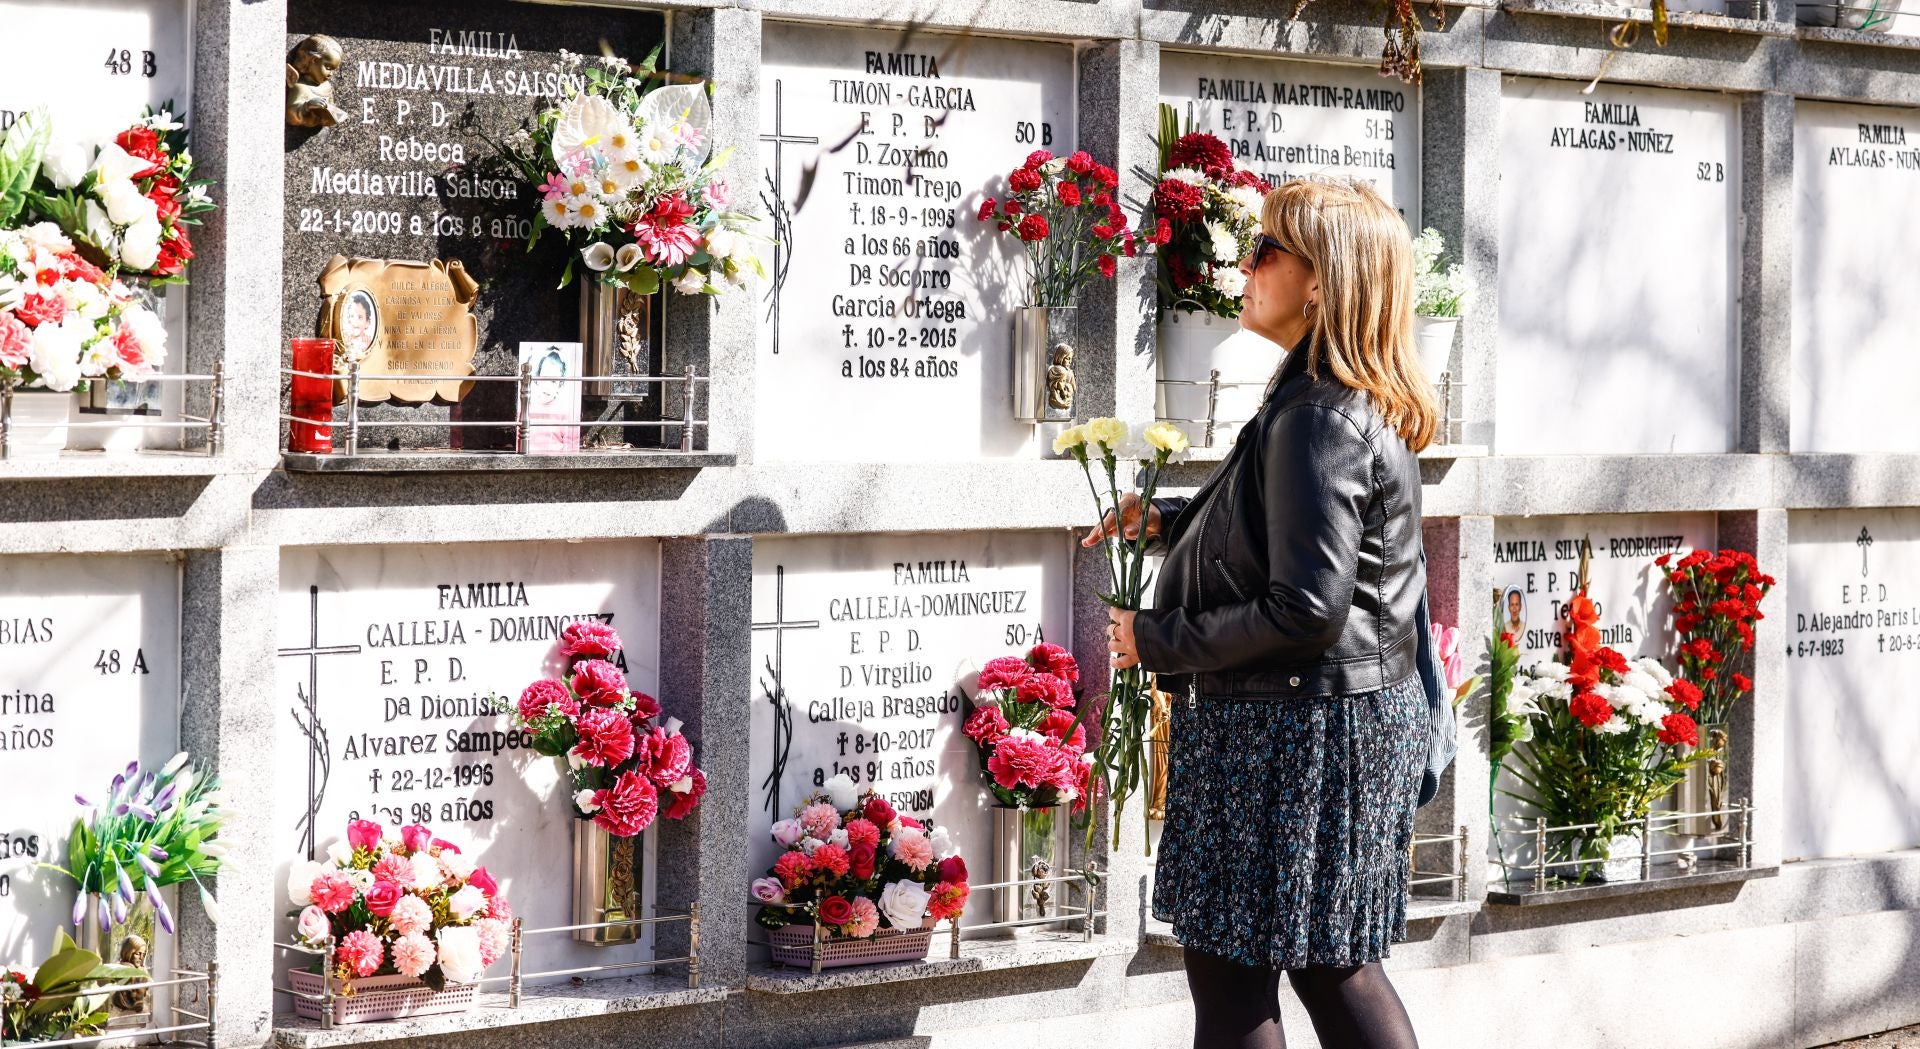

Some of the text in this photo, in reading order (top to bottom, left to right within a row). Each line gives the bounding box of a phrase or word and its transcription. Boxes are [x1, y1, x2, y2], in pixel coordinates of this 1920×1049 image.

[429, 28, 522, 59] FAMILIA
[104, 48, 157, 78] 48 B
[865, 51, 940, 79] FAMILIA
[830, 79, 891, 106] TIMON
[908, 86, 976, 111] GARCIA
[1198, 77, 1405, 113] FAMILIA MARTIN-RAMIRO
[362, 98, 450, 127] E. P. D.
[860, 111, 939, 138] E. P. D.
[1223, 108, 1235, 131] E.
[1247, 110, 1260, 133] P.
[1584, 101, 1640, 127] FAMILIA
[1015, 121, 1053, 146] 50 B
[1365, 118, 1394, 141] 51-B
[1551, 127, 1616, 151] AYLAGAS
[1628, 128, 1673, 154] NUÑEZ
[1858, 123, 1906, 145] FAMILIA
[379, 136, 465, 164] Rebeca
[856, 141, 948, 169] D. Zoximo
[1255, 140, 1339, 167] Aurentina
[1344, 145, 1396, 169] Benita
[1829, 146, 1885, 168] AYLAGAS
[311, 167, 437, 197] Mediavilla
[1697, 162, 1724, 183] 52 B
[843, 172, 962, 202] Timon Trejo
[300, 209, 541, 240] 22-1-2009 a los 8 año
[845, 234, 960, 259] a los 66 años
[879, 266, 951, 289] Socorro
[904, 297, 966, 323] Ortega
[405, 325, 415, 335] EN
[414, 341, 424, 350] EN
[387, 361, 454, 370] SIGUE SONRIENDO
[842, 356, 958, 378] a los 84 años
[1494, 540, 1547, 563] AMILIA
[1610, 535, 1684, 558] RODRIGUEZ
[893, 560, 970, 586] FAMILIA
[1527, 573, 1538, 593] E.
[1548, 572, 1560, 593] P.
[437, 581, 529, 610] FAMILIA
[829, 591, 1027, 622] CALLEJA-DOMINGUEZ
[1842, 585, 1851, 604] E.
[1861, 584, 1870, 603] P.
[366, 620, 466, 648] CALLEJA
[1797, 613, 1807, 633] D.
[1810, 611, 1873, 633] Alejandro
[1877, 608, 1908, 628] Paris
[850, 631, 864, 654] E.
[908, 629, 922, 651] D.
[1005, 623, 1044, 646] 50-A
[1526, 630, 1563, 649] Silva
[1798, 638, 1844, 658] 6-7-1923
[94, 648, 149, 675] 48 A
[381, 657, 466, 685] E. P. D.
[861, 662, 932, 689] Virgilio
[1, 689, 55, 715] rina
[808, 691, 959, 723] Calleja Bragado
[343, 732, 437, 761] Alvarez
[855, 728, 935, 752] 8-10-2017
[391, 764, 493, 792] 22-12-1996
[813, 767, 824, 787] a
[866, 761, 883, 783] 91
[890, 756, 935, 780] años
[411, 803, 432, 825] 98
[441, 797, 494, 823] años
[890, 789, 935, 811] ESPOSA
